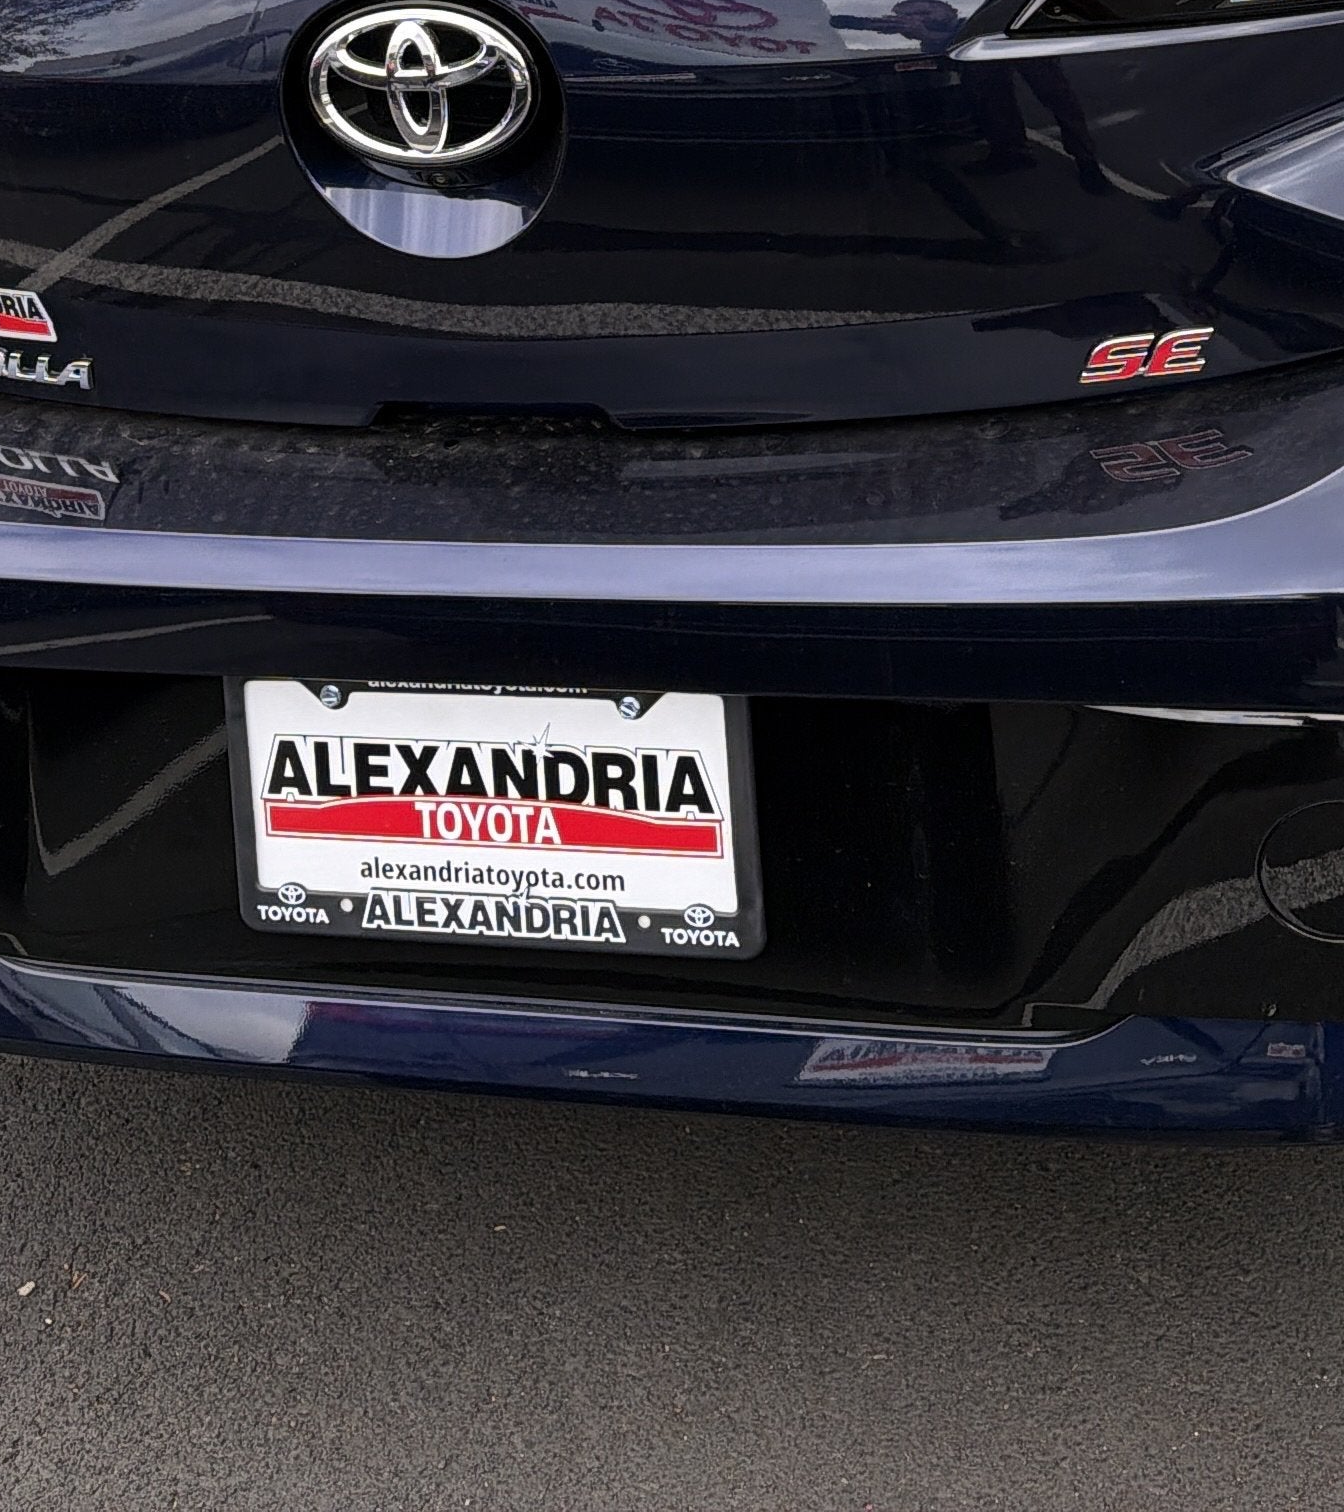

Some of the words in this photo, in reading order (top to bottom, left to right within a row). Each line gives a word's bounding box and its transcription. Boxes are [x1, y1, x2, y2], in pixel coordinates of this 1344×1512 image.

[1079, 326, 1215, 384] SE
[266, 739, 715, 815] ALEXANDRIA
[414, 802, 562, 845] TOYOTA
[360, 857, 626, 892] alexandriatoyota.com
[257, 905, 330, 925] TOYOTA
[362, 889, 626, 943] ALEXANDRIA
[661, 926, 740, 948] TOYOTA
